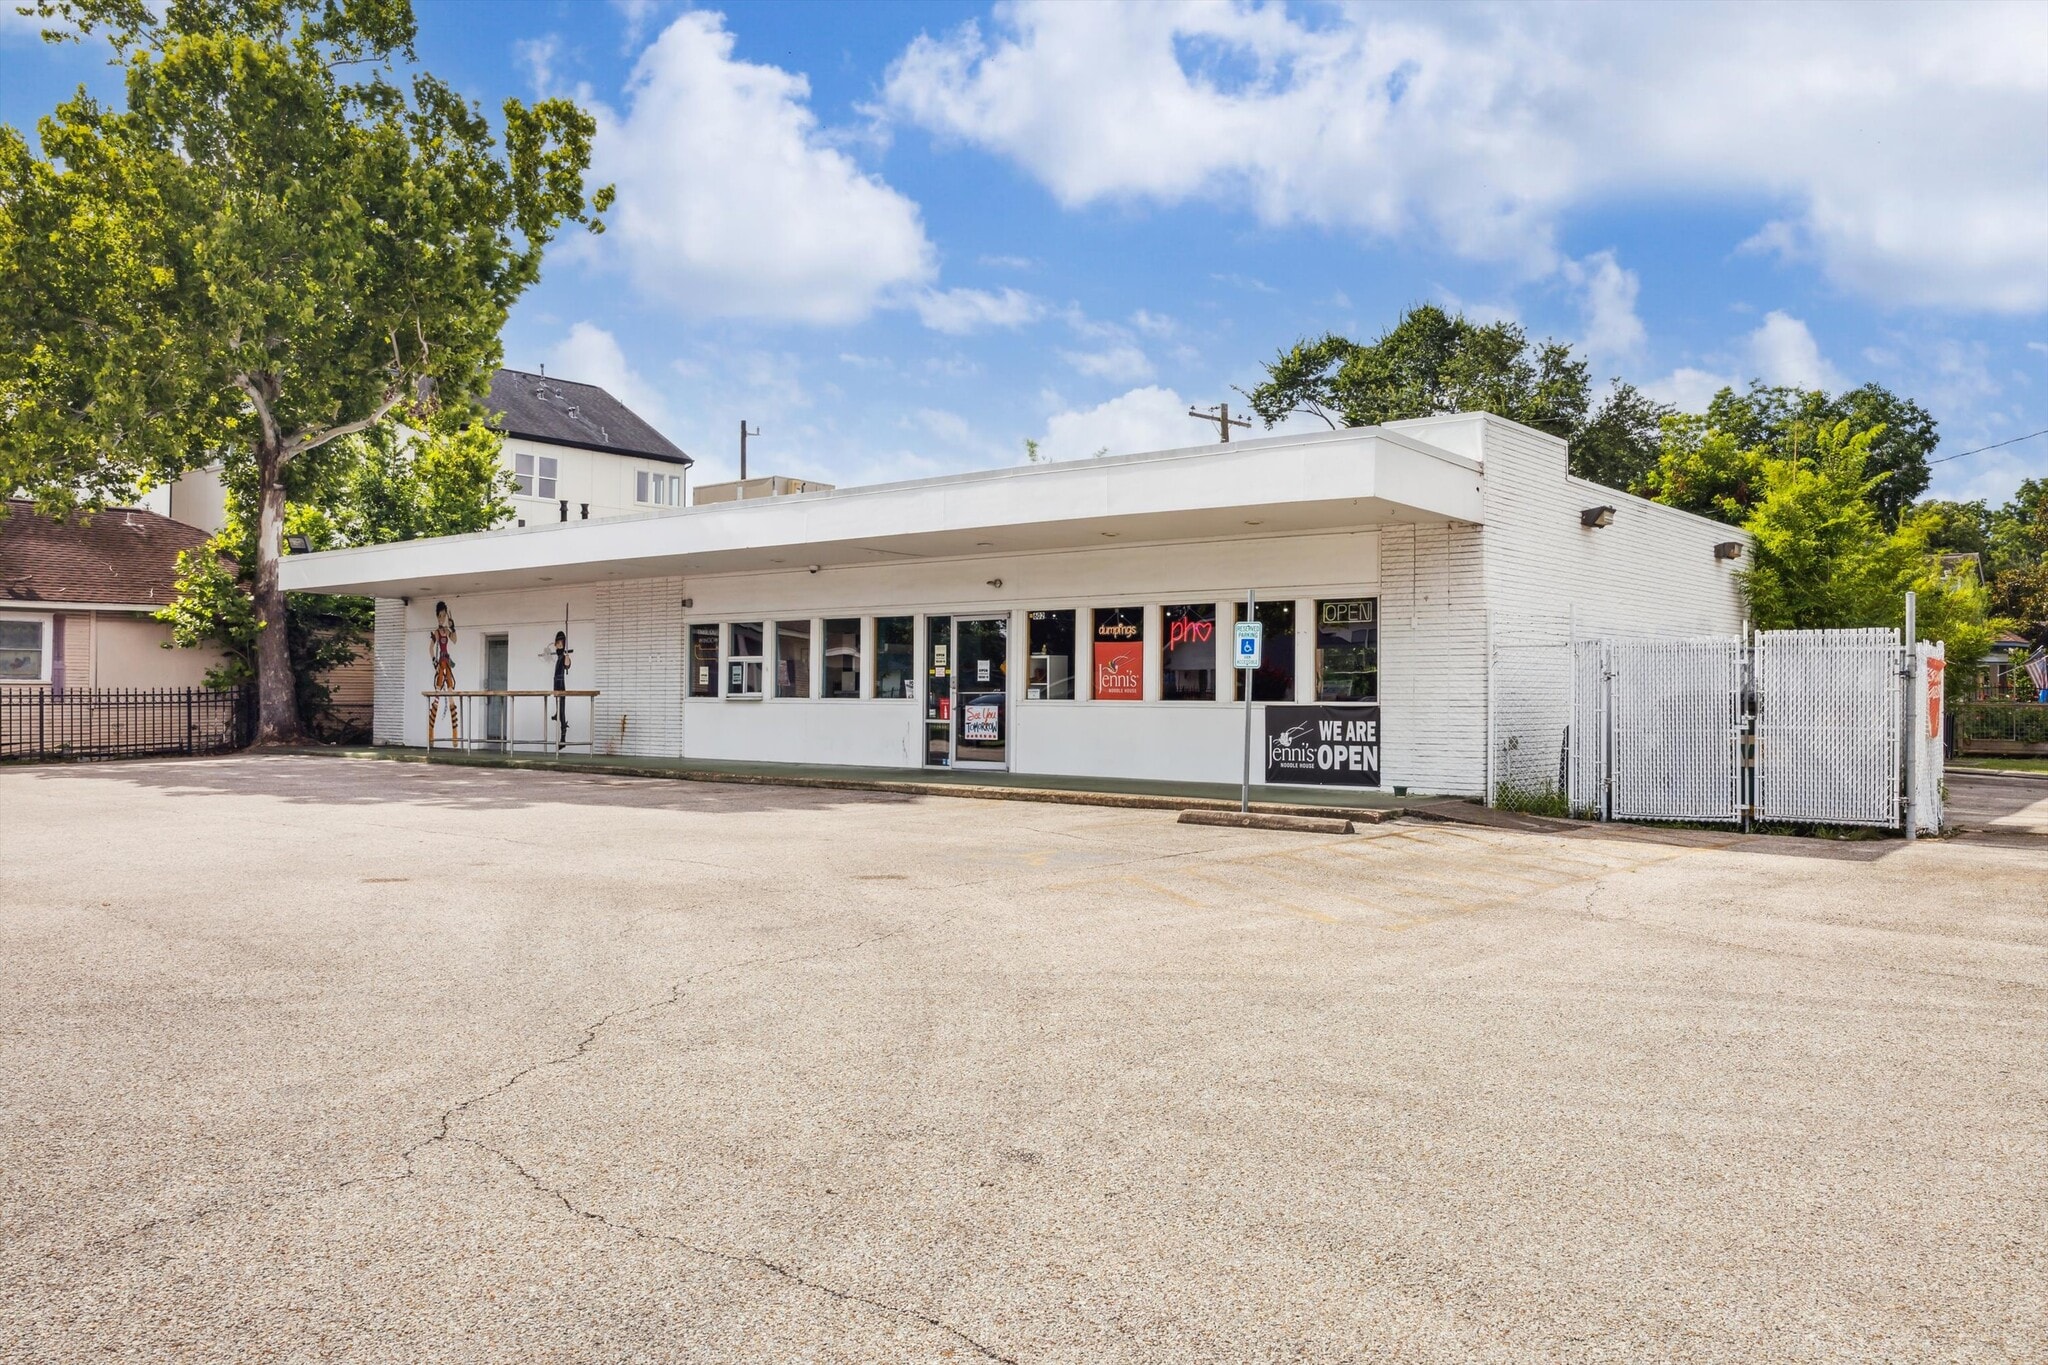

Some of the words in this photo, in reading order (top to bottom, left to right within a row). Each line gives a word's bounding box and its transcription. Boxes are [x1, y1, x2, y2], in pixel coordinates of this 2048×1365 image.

[1325, 603, 1370, 621] OPEN
[1099, 623, 1137, 638] dumplings
[1099, 663, 1137, 694] Jenni's
[966, 707, 981, 722] See
[982, 707, 997, 726] You
[965, 721, 998, 733] TOMORROW
[1318, 720, 1342, 741] WE
[1345, 720, 1377, 742] ARE
[1268, 735, 1315, 769] Jenni's
[1317, 744, 1378, 772] OPEN
